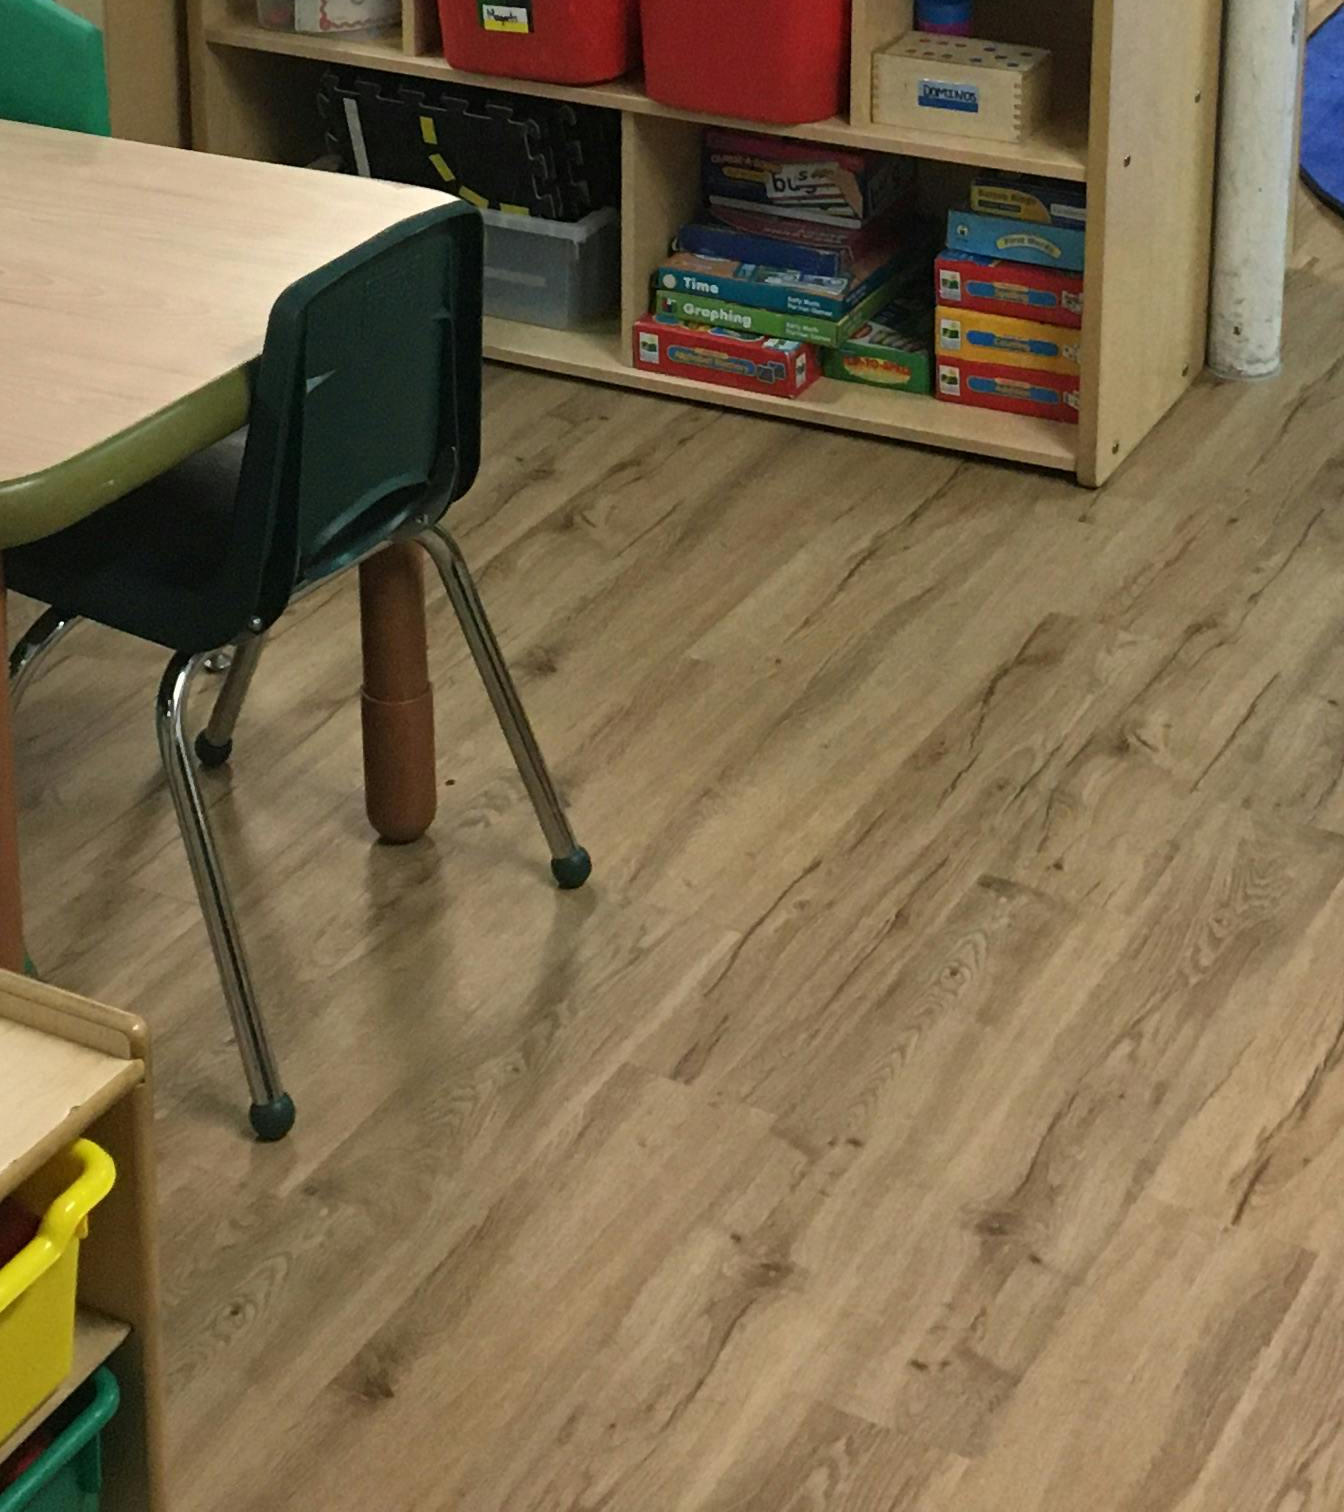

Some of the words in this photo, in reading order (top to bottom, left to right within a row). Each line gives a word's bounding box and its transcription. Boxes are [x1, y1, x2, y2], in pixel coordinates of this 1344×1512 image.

[922, 83, 977, 104] DOMINOS
[683, 276, 720, 295] Time
[683, 302, 752, 329] Graphing
